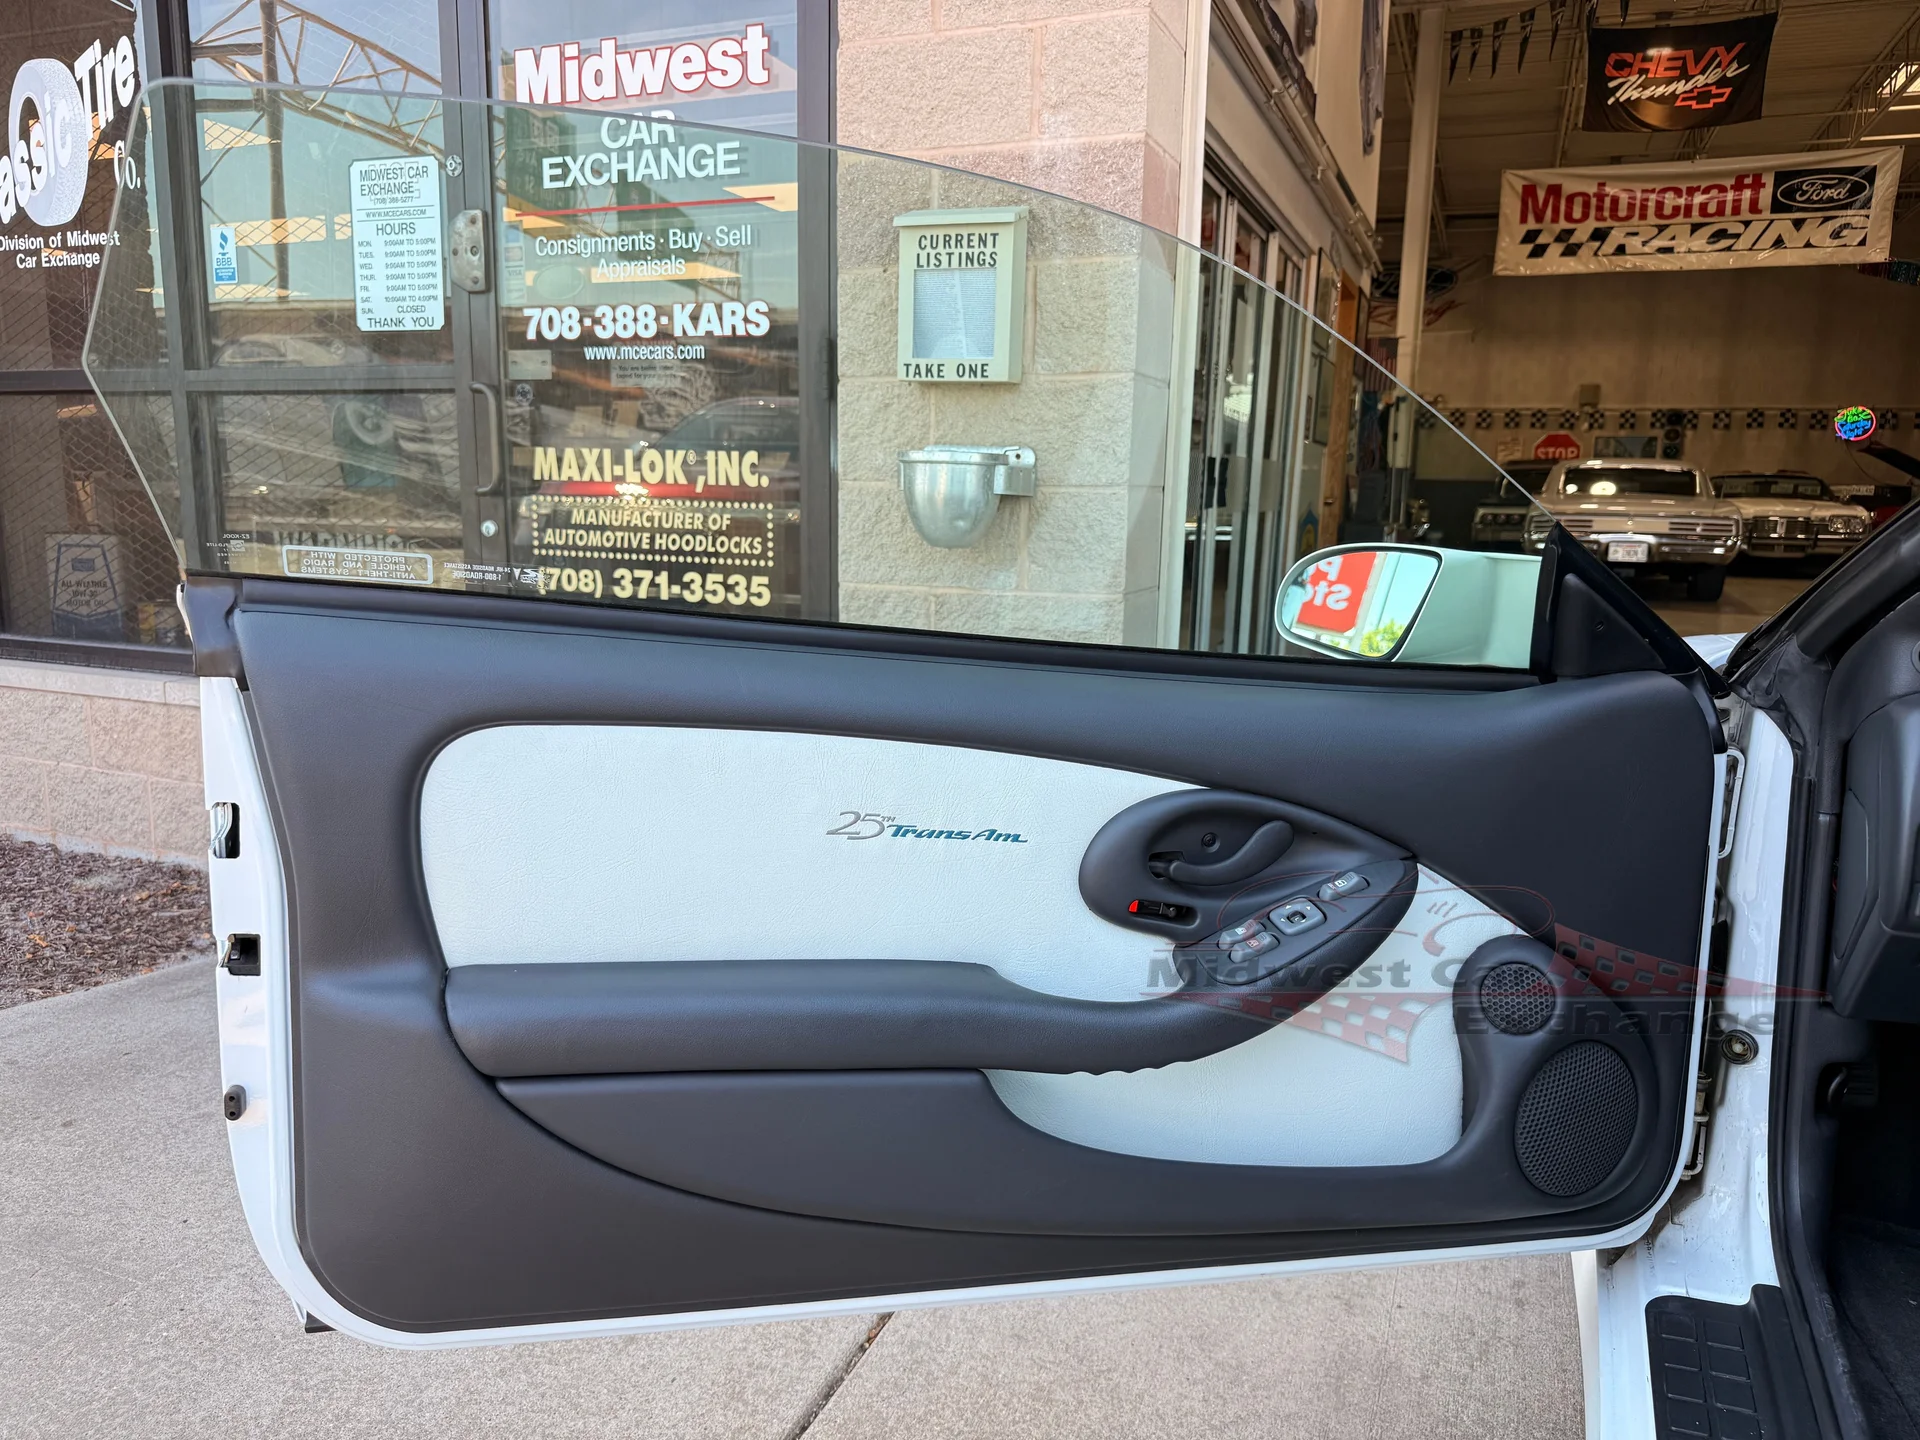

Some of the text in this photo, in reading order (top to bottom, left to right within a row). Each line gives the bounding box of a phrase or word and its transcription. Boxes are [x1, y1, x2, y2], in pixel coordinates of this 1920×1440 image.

[513, 22, 770, 104] Midwest
[1604, 42, 1747, 78] CHEVY
[73, 36, 135, 143] Tire
[1607, 57, 1750, 105] Thunder
[600, 109, 675, 149] CAR
[360, 165, 429, 182] MIDWEST CAR
[541, 140, 741, 189] EXCHANGE
[360, 181, 414, 196] EXCHANGE
[1519, 173, 1851, 224] Motorcraft Ford
[366, 208, 426, 218] WWW.MCECARS.COM
[376, 222, 416, 236] HOURS
[1594, 214, 1871, 256] RACING
[49, 232, 62, 248] of
[66, 230, 121, 248] Midwest
[535, 232, 656, 258] Consignments
[668, 228, 703, 253] Buy
[715, 224, 751, 246] Sell
[918, 233, 999, 250] CURRENT
[16, 250, 100, 268] Car Exchange
[216, 257, 232, 266] BBB
[597, 254, 686, 280] Appraisals
[916, 251, 998, 268] LISTINGS
[408, 272, 416, 280] TO
[396, 305, 426, 314] CLOSED
[367, 316, 434, 328] THANK YOU
[583, 343, 706, 360] www.mcecars.com
[904, 362, 990, 379] TAKE ONE
[1536, 447, 1579, 460] STOP
[570, 508, 732, 531] MANUFACTURER OF
[543, 528, 763, 554] AUTOMOTIVE HOODLOCKS
[612, 568, 772, 607] 371-3535
[886, 824, 972, 840] Trans
[972, 828, 1028, 843] Am
